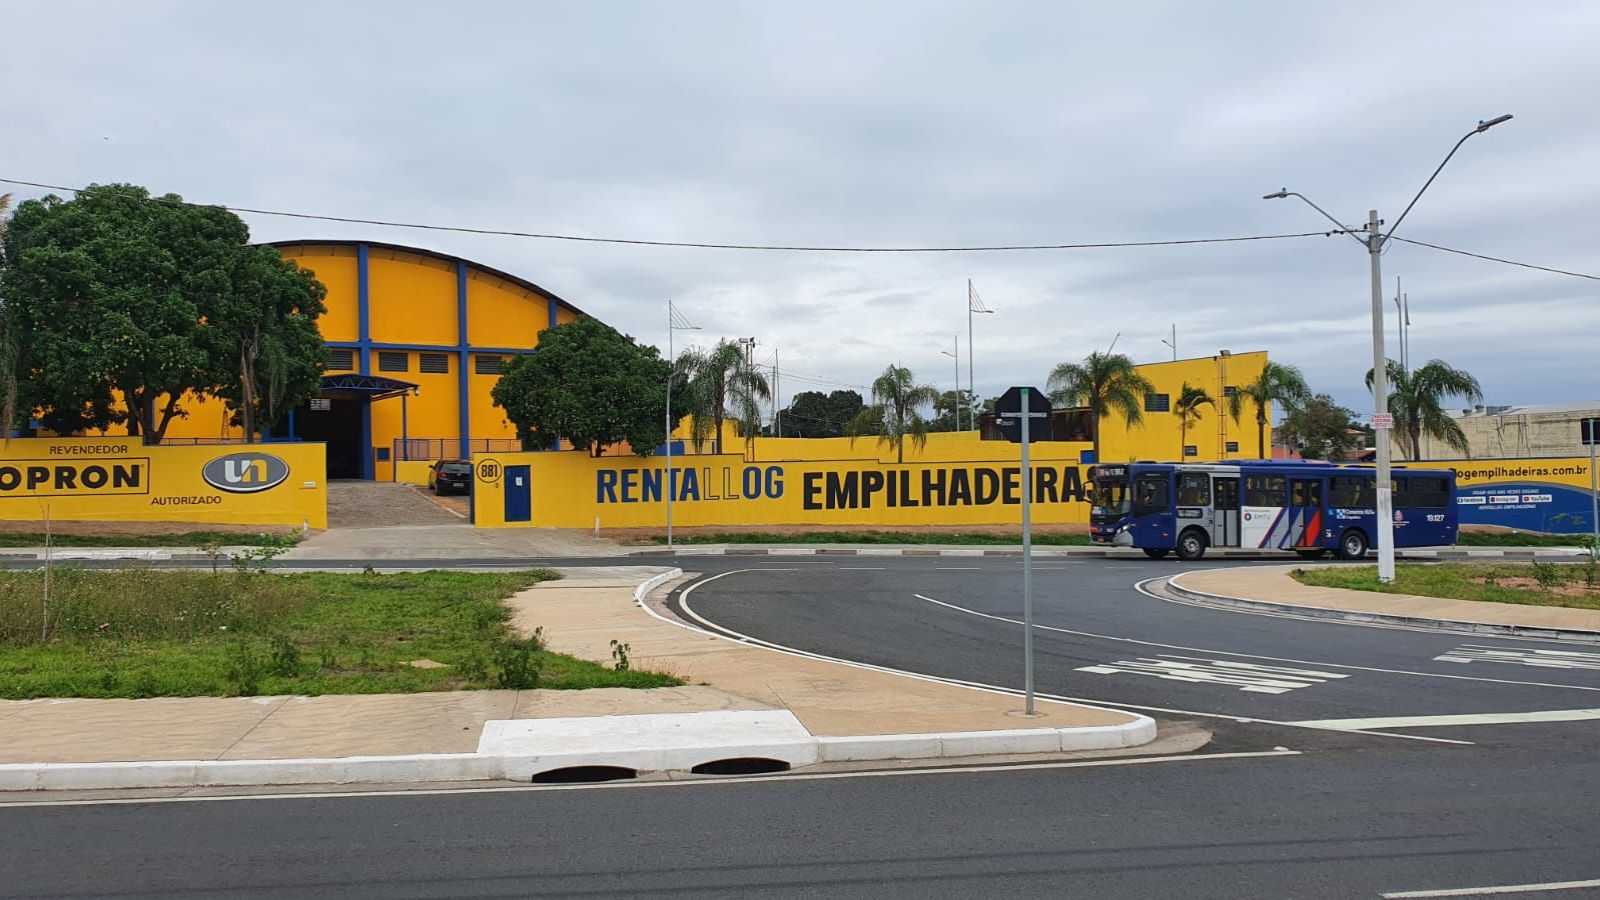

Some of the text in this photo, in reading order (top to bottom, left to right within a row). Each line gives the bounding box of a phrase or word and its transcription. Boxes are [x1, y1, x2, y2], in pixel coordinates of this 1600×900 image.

[49, 445, 128, 455] REVENDEDOR
[0, 464, 140, 491] OPRON
[481, 464, 498, 478] 881
[596, 465, 784, 503] RENTALLOG
[151, 496, 222, 506] AUTORIZADO
